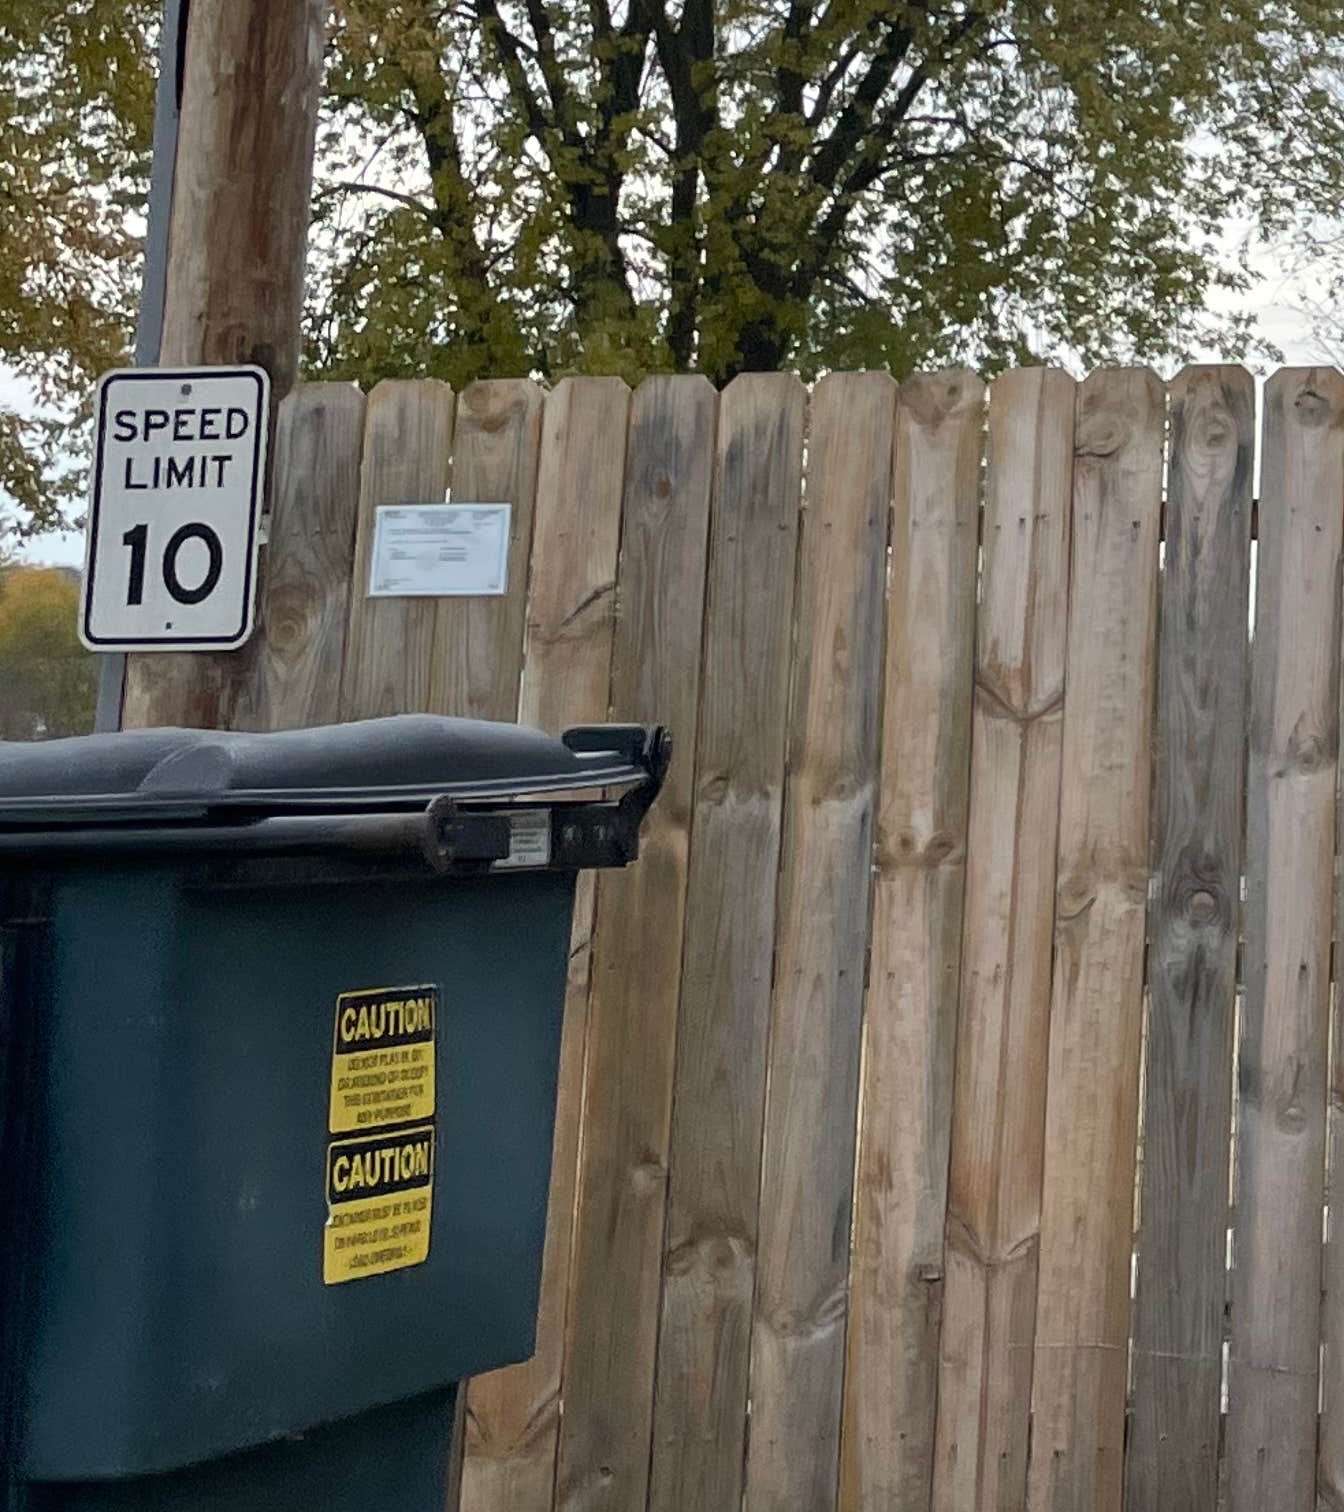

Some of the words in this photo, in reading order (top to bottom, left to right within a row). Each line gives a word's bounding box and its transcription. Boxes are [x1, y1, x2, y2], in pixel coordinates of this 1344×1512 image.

[113, 407, 250, 443] SPEED
[124, 454, 233, 490] LIMIT
[122, 522, 224, 606] 10
[340, 998, 431, 1043] CAUTION
[332, 1141, 429, 1193] CAUTION
